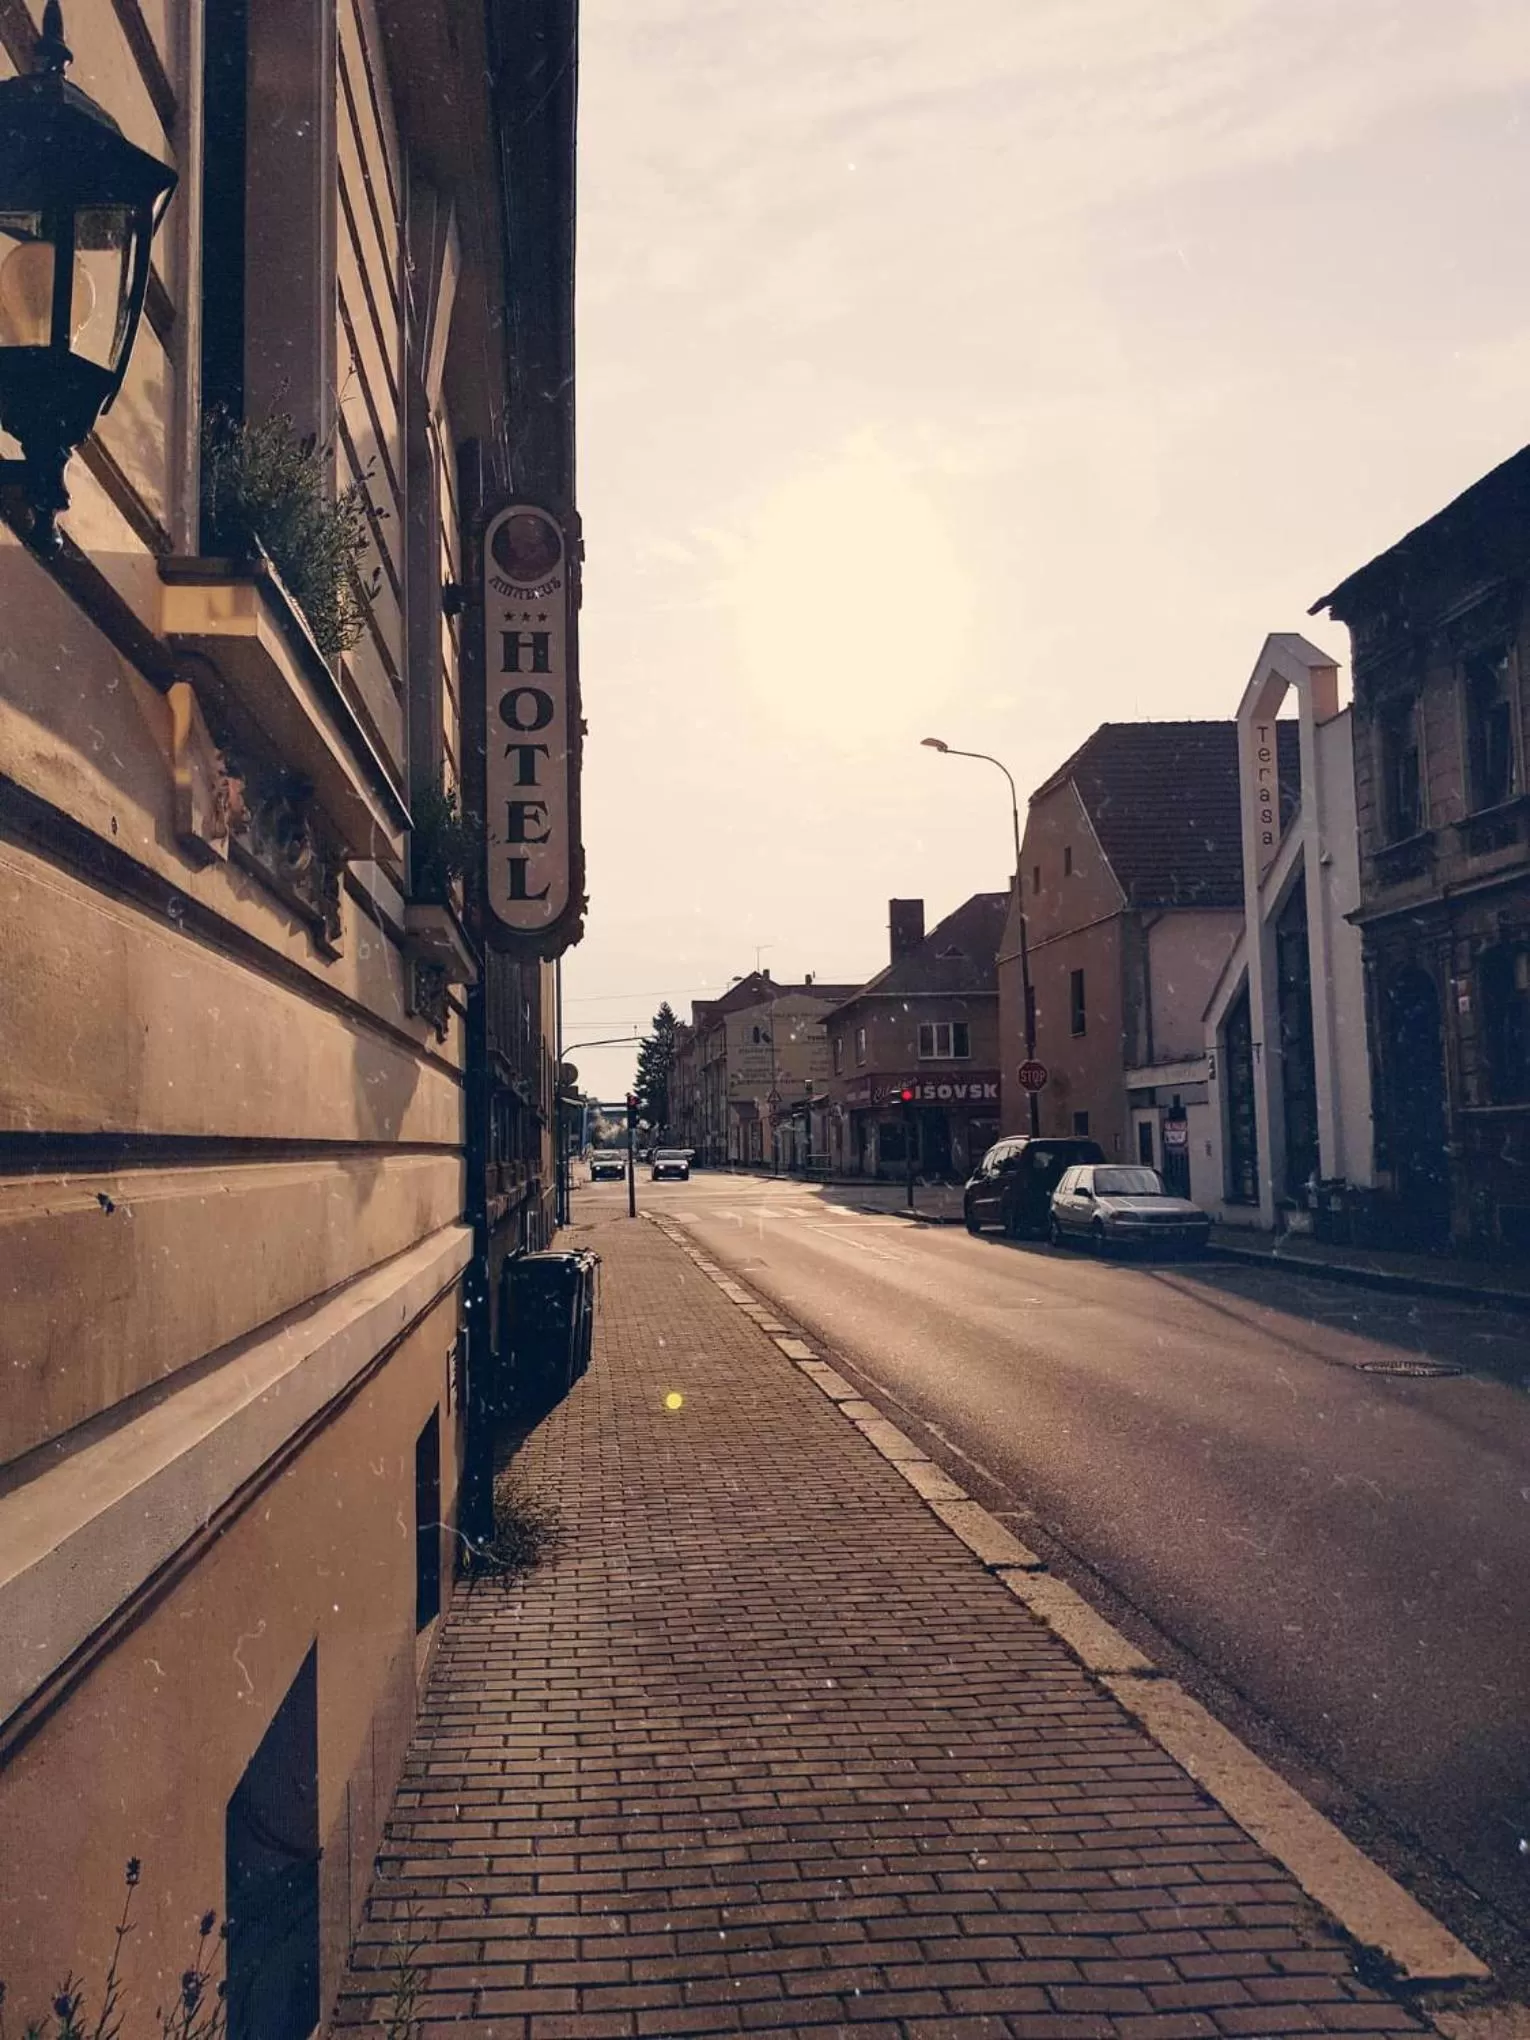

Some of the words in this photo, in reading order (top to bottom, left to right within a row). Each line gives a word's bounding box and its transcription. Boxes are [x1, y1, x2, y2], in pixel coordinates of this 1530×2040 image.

[498, 630, 554, 901] HOTEL
[1257, 726, 1273, 846] Terasa
[914, 1080, 998, 1100] IŠOVSK
[1020, 1070, 1045, 1083] STOP
